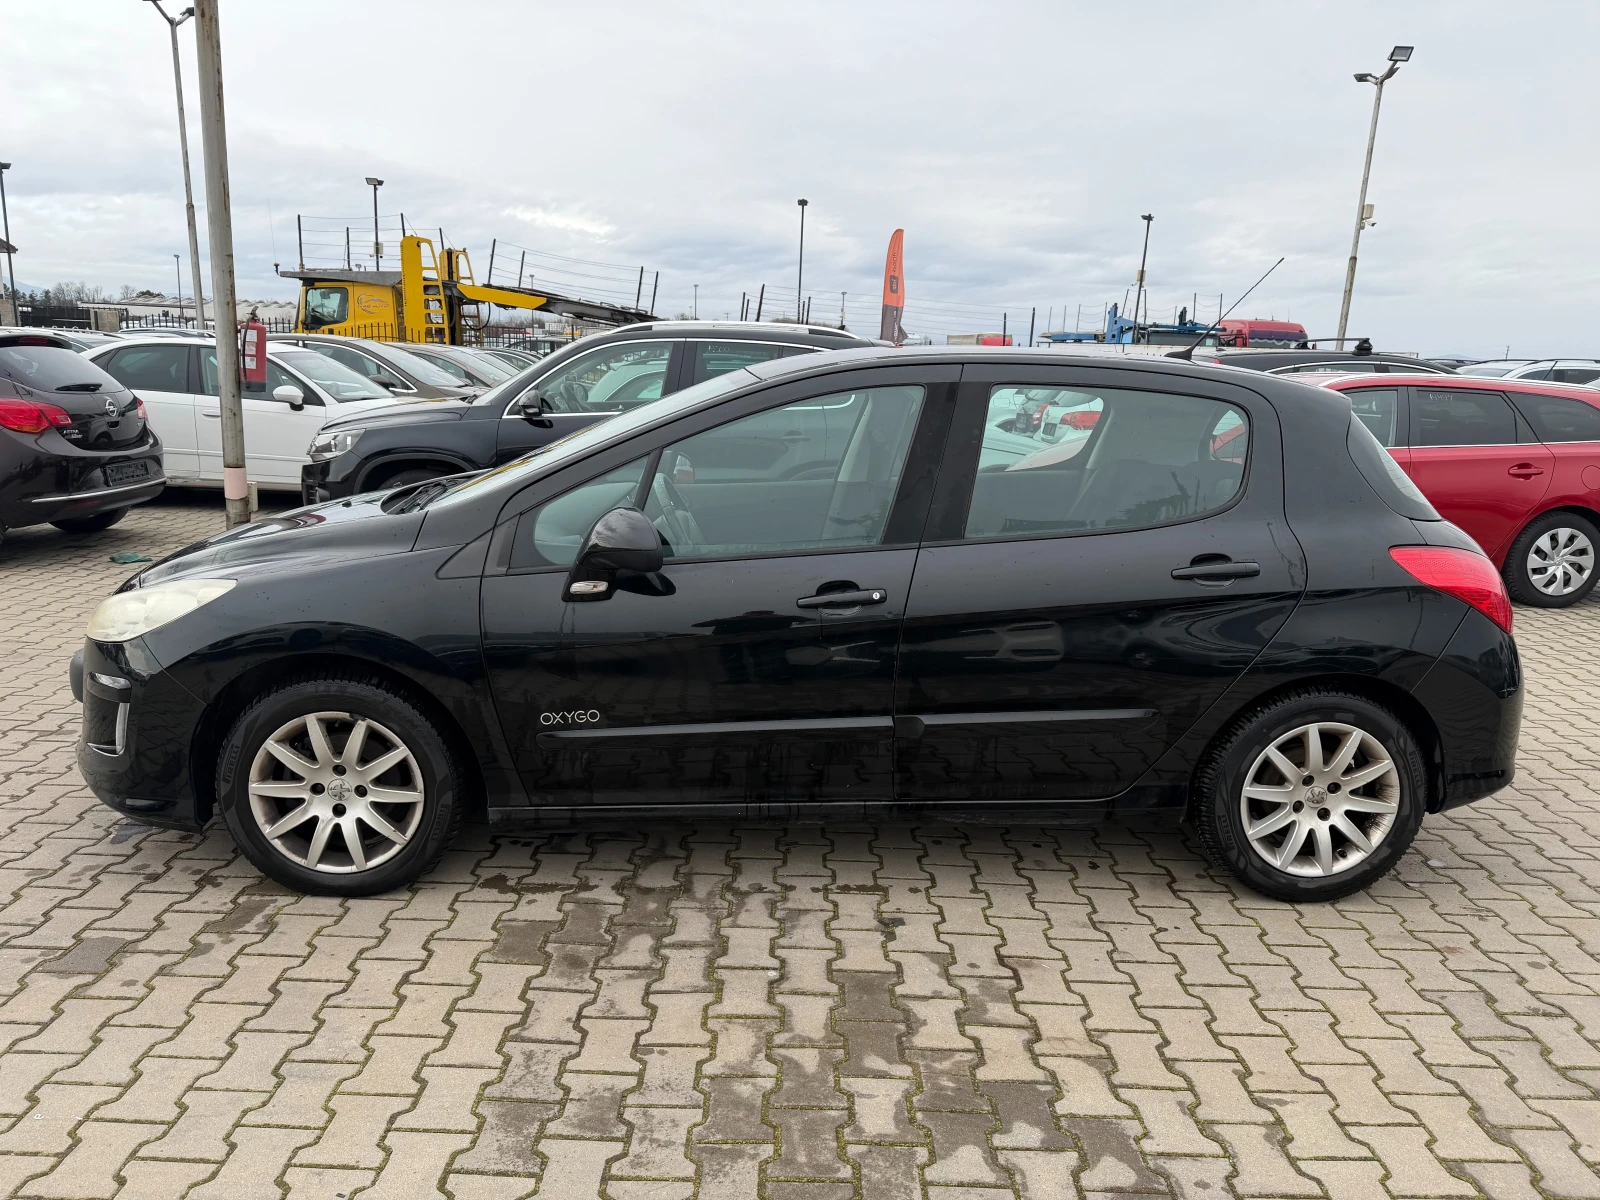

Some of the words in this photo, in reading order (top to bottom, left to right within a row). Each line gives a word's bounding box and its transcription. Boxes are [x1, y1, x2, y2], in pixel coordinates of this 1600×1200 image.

[540, 709, 600, 725] OXYGO
[221, 742, 241, 785] PIRELLI
[430, 803, 451, 841] PIRELLI
[1216, 813, 1237, 851] PIRELLI
